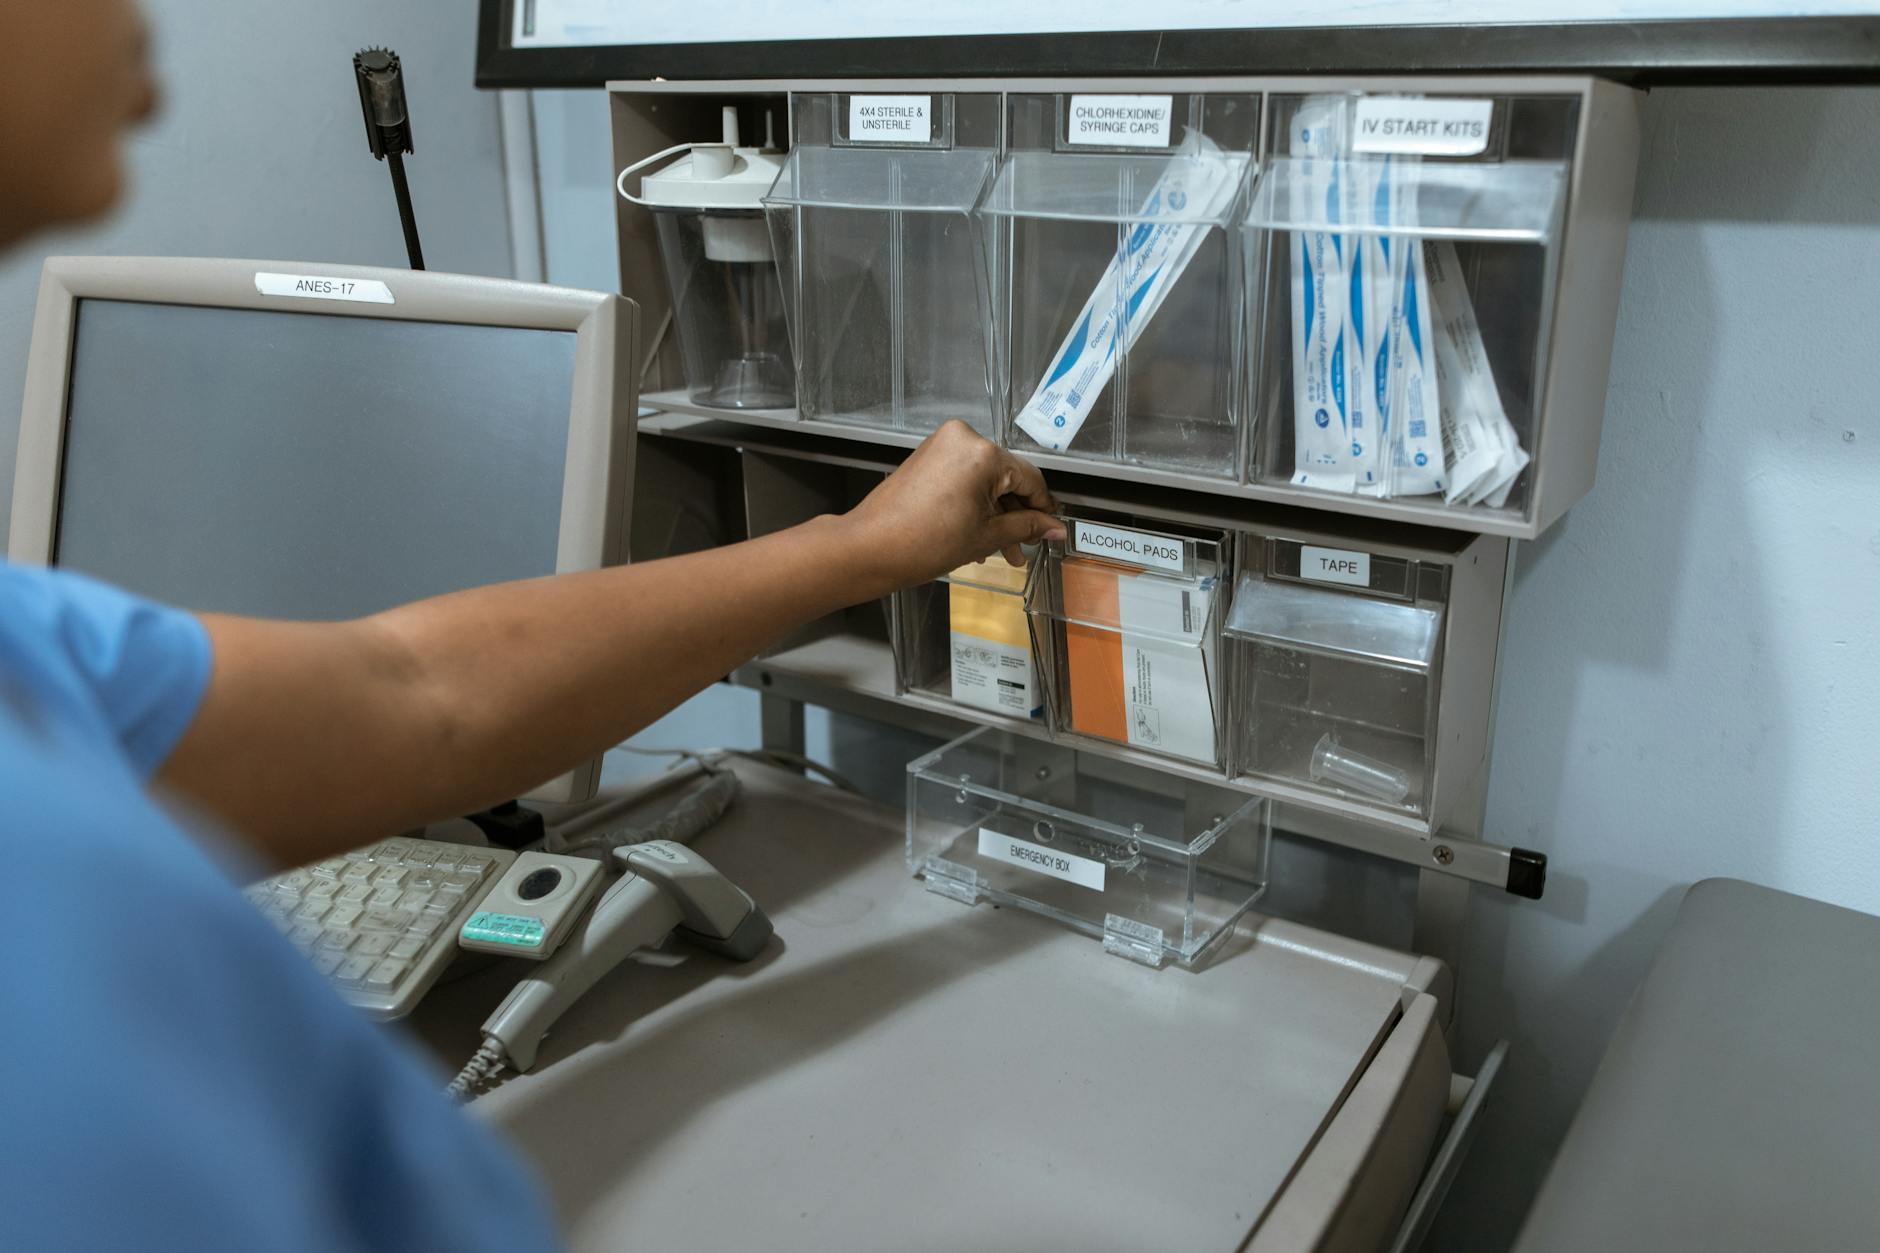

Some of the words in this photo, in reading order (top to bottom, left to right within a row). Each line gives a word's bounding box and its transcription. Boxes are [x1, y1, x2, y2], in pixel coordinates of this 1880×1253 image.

[860, 106, 875, 116] 4X4
[878, 107, 914, 118] STERILE
[916, 107, 923, 117] &
[1076, 107, 1166, 121] CHLORHEXIDINE/
[862, 120, 911, 130] UNSTERILE
[1080, 121, 1127, 134] SYRINGE
[1130, 122, 1159, 135] CAPS
[1362, 119, 1380, 134] IV
[1383, 119, 1439, 136] START
[1443, 121, 1483, 138] KITS
[296, 280, 355, 295] ANES-17
[1091, 319, 1110, 349] Cotton
[1081, 532, 1140, 554] ALCOHOL
[1143, 544, 1178, 561] PADS
[1320, 558, 1358, 574] TAPE
[1010, 845, 1054, 868] EMERGENCY
[1056, 858, 1071, 873] BOX
